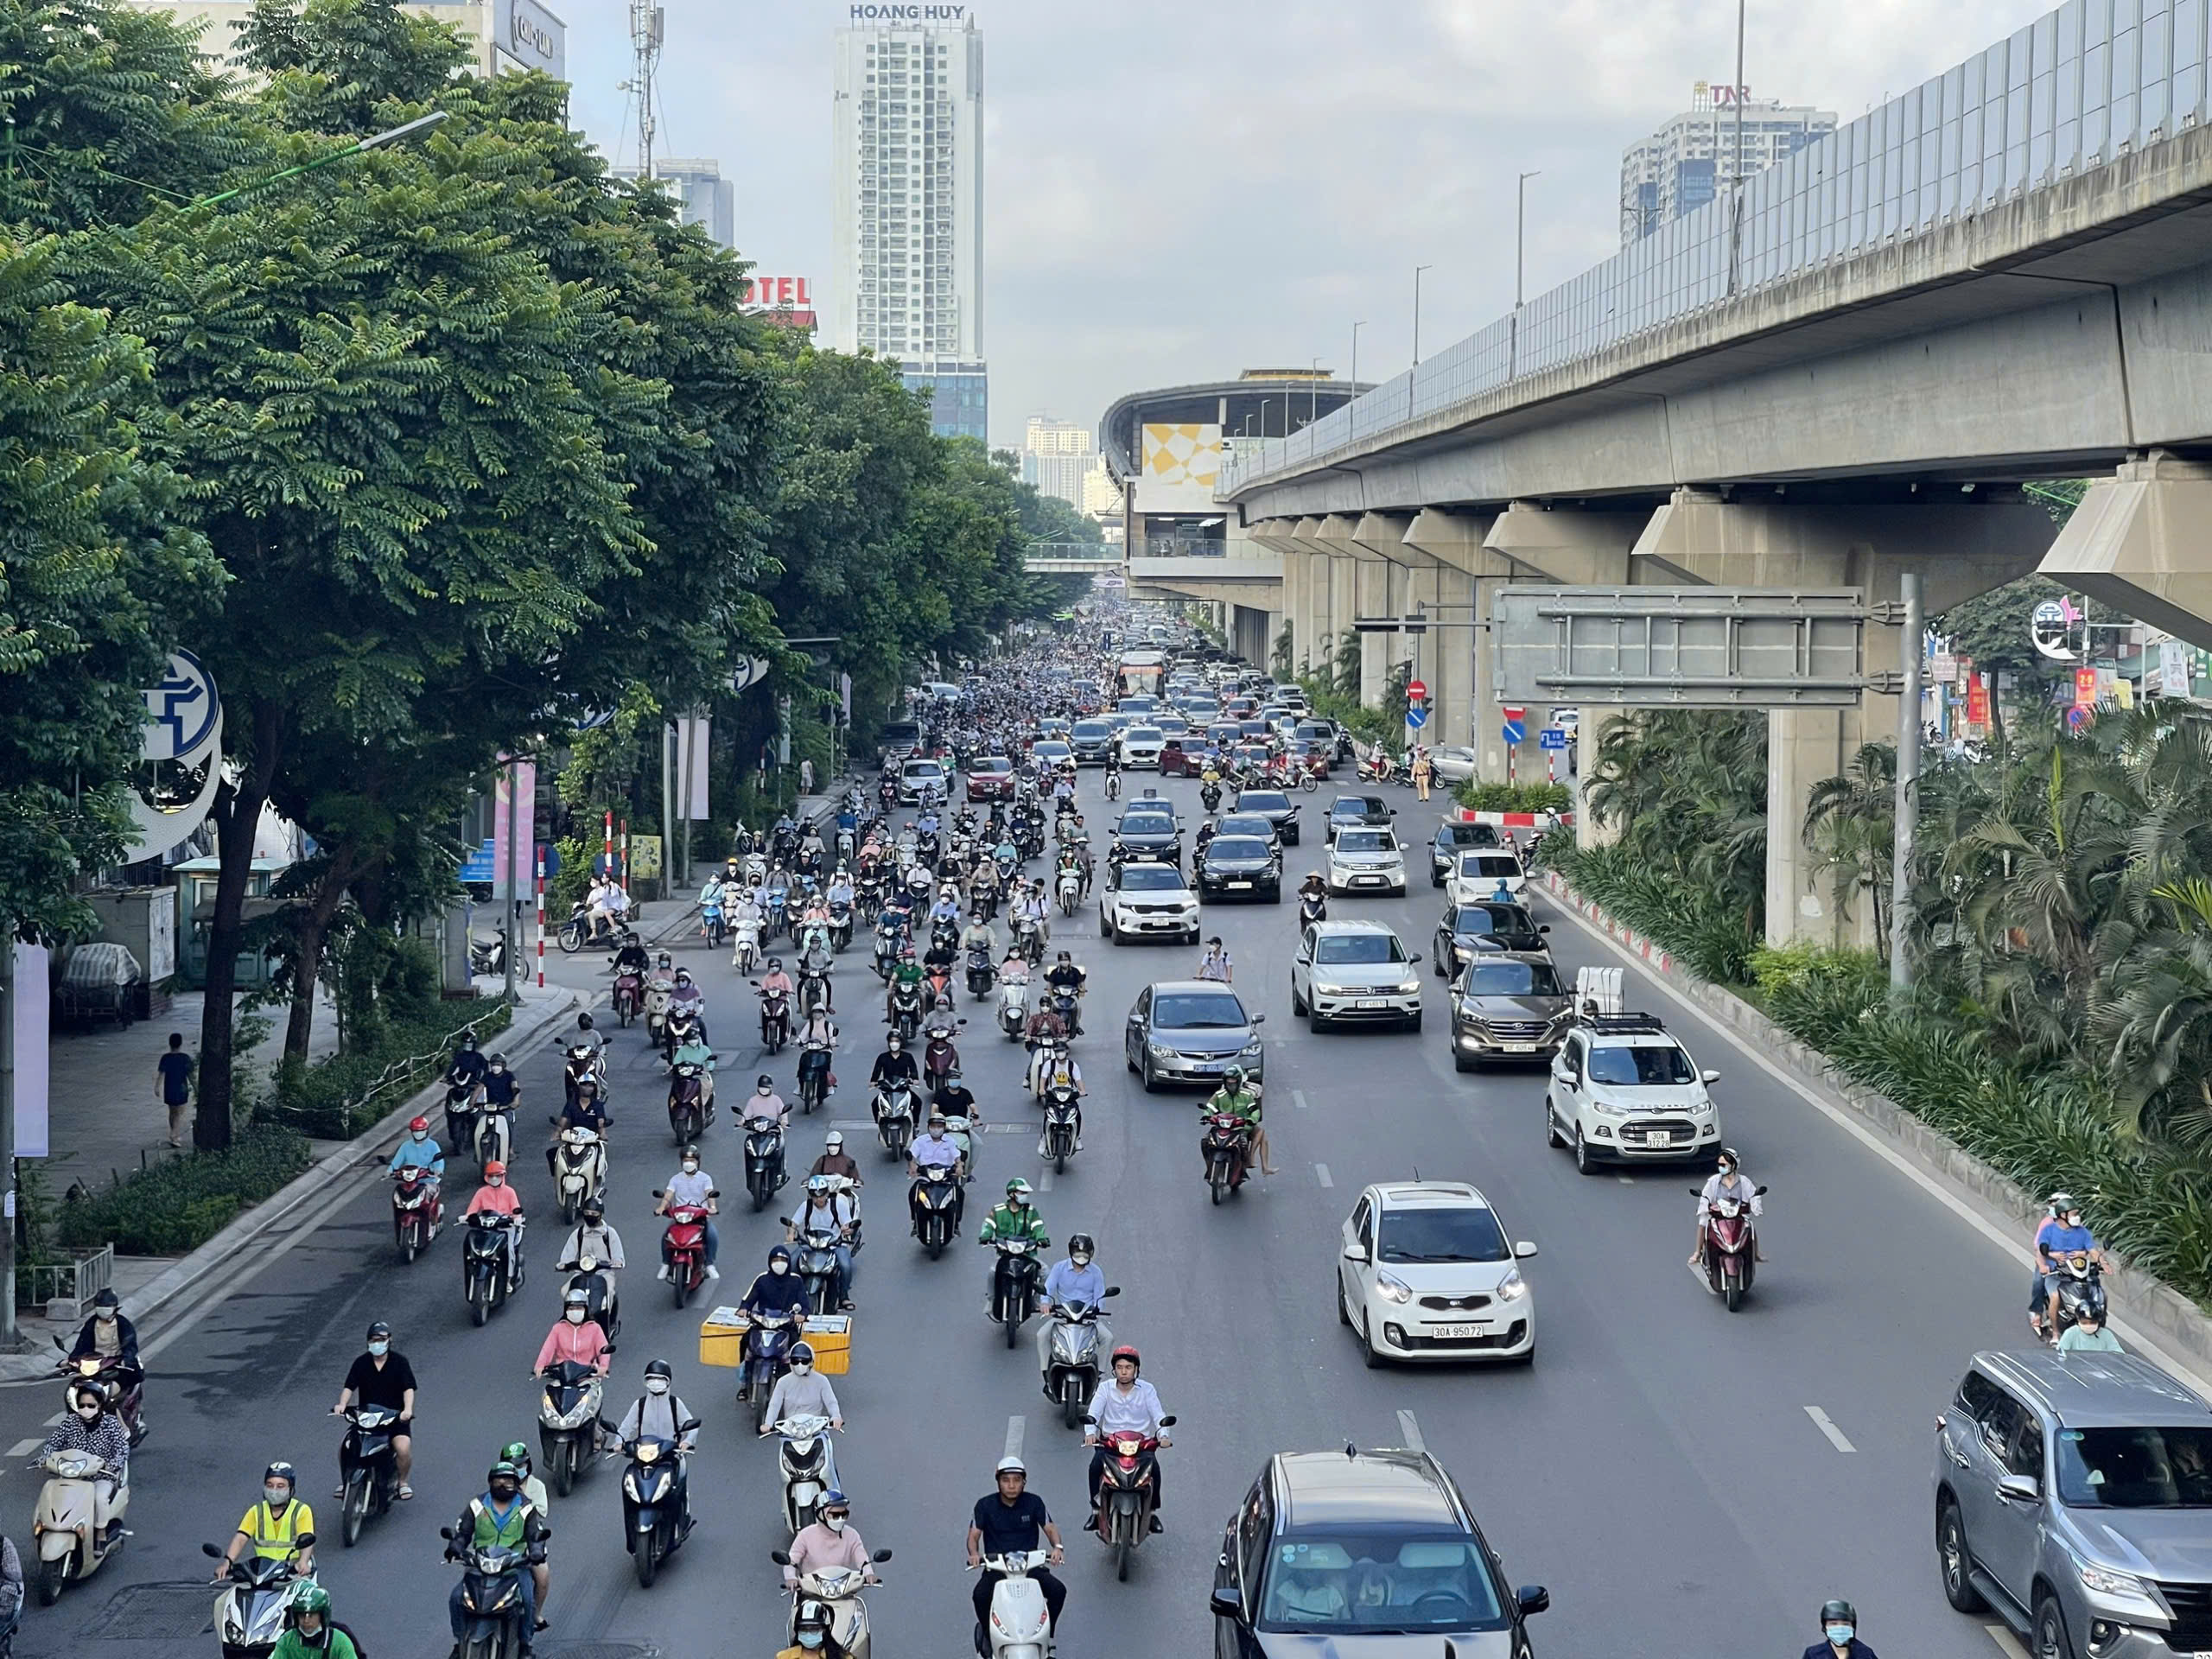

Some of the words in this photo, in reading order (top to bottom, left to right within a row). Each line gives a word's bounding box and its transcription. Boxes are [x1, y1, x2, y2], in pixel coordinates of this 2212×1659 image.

[850, 4, 919, 19] HOANG
[925, 5, 965, 20] HUY
[1710, 85, 1751, 103] TNR
